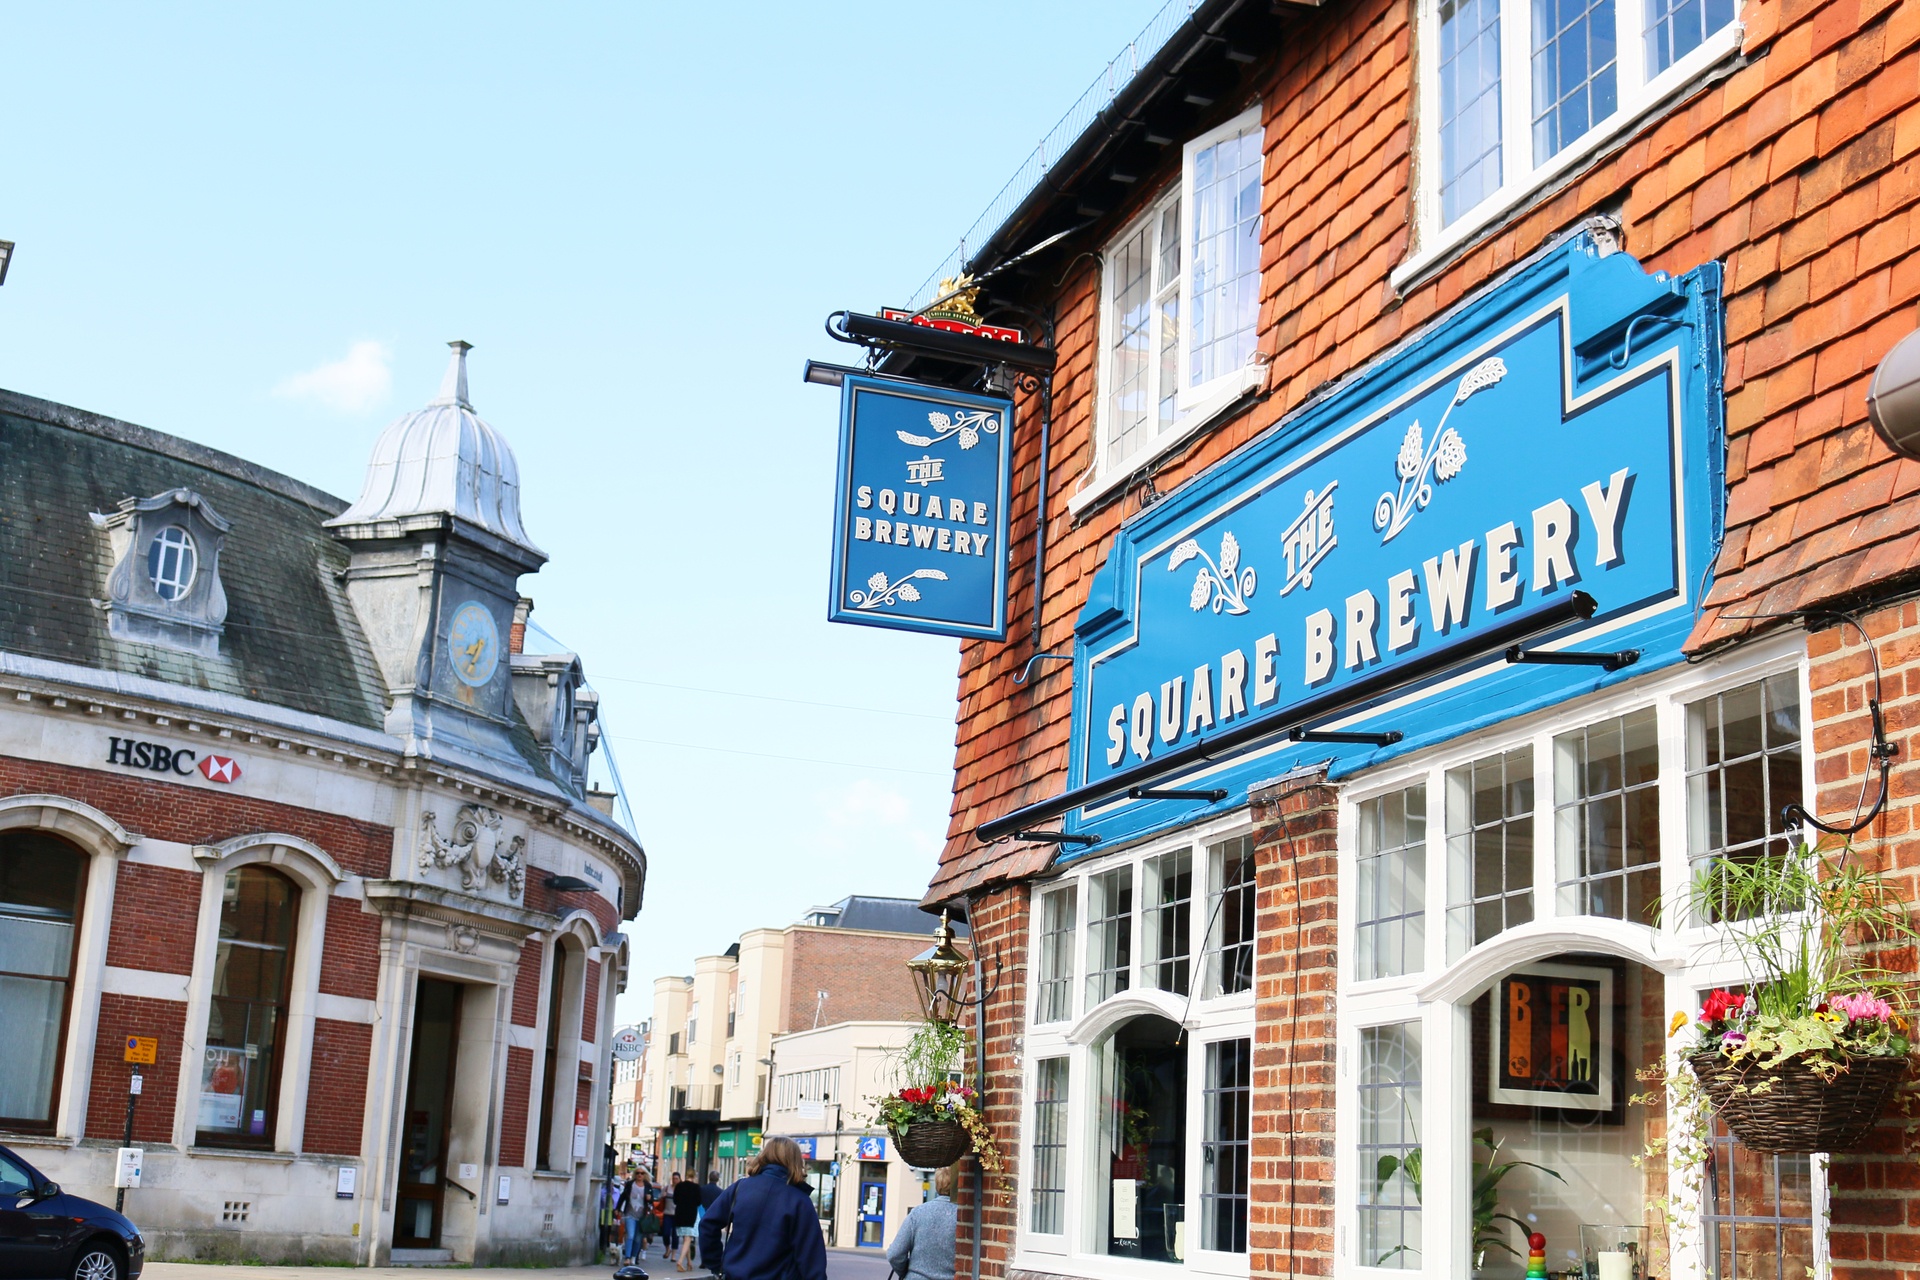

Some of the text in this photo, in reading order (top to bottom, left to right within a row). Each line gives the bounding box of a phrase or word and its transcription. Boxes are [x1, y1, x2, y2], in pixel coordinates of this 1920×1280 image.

[907, 462, 943, 480] THE
[857, 485, 988, 525] SQUARE
[855, 516, 989, 556] BREWERY
[1282, 493, 1334, 581] THE
[1106, 467, 1630, 767] SQUARE BREWERY
[106, 736, 196, 776] HSBC
[615, 1042, 642, 1053] HSBC
[1508, 981, 1591, 1082] BER
